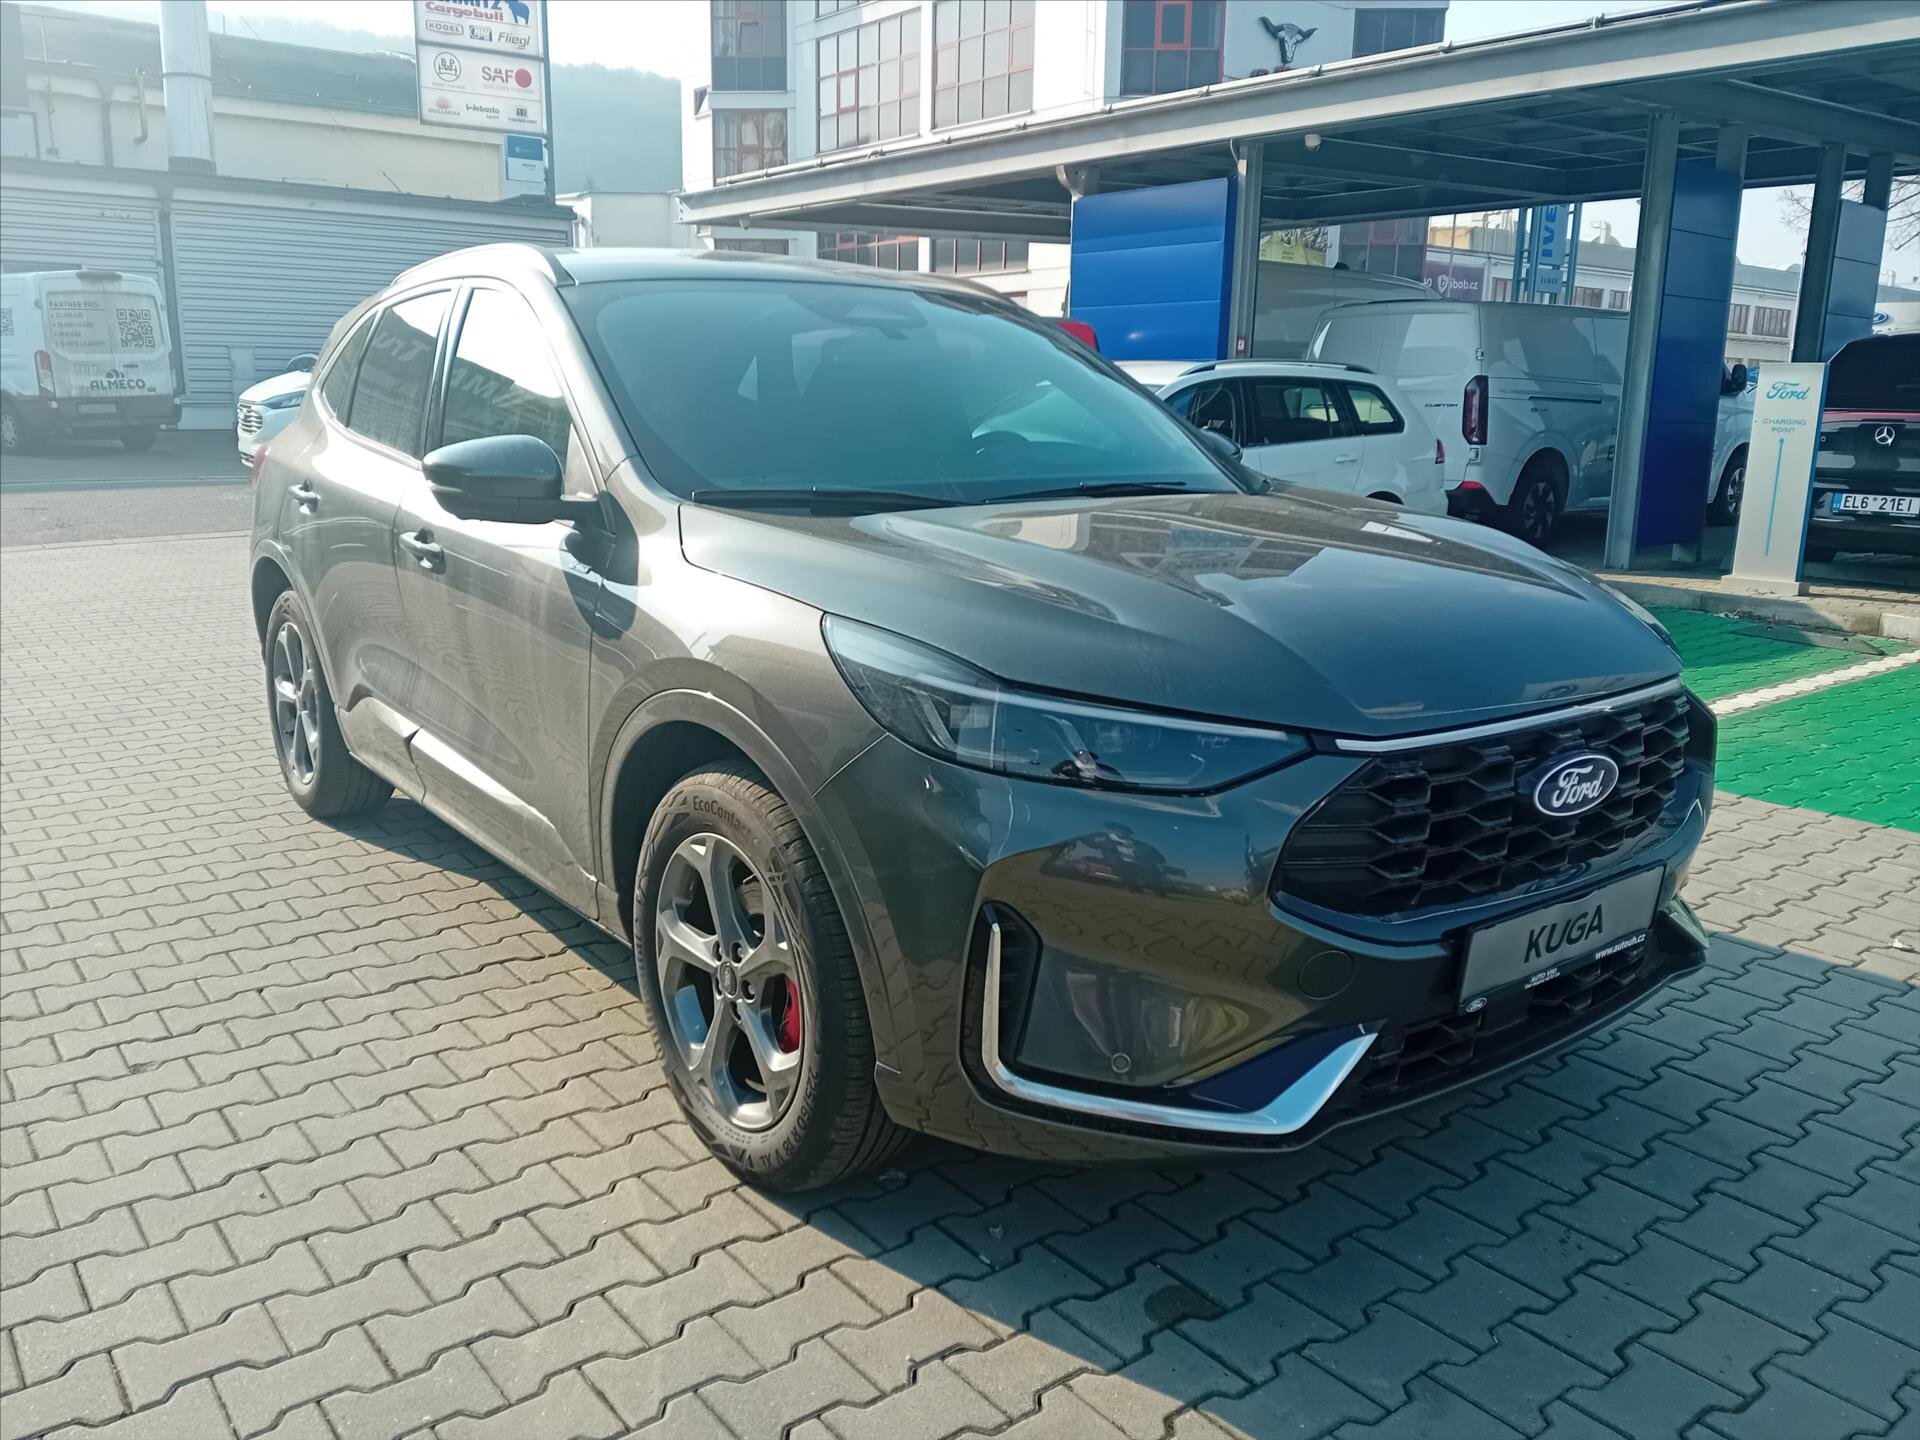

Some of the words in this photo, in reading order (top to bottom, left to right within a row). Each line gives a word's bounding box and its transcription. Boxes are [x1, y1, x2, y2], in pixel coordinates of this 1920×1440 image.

[424, 1, 504, 21] Cargobull
[497, 32, 531, 49] Fliegl
[1542, 206, 1557, 257] IVE
[90, 379, 146, 390] ALMECO
[1766, 381, 1811, 400] Ford
[1843, 495, 1869, 509] EL6
[1552, 764, 1605, 808] Ford
[1524, 904, 1603, 962] KUGA
